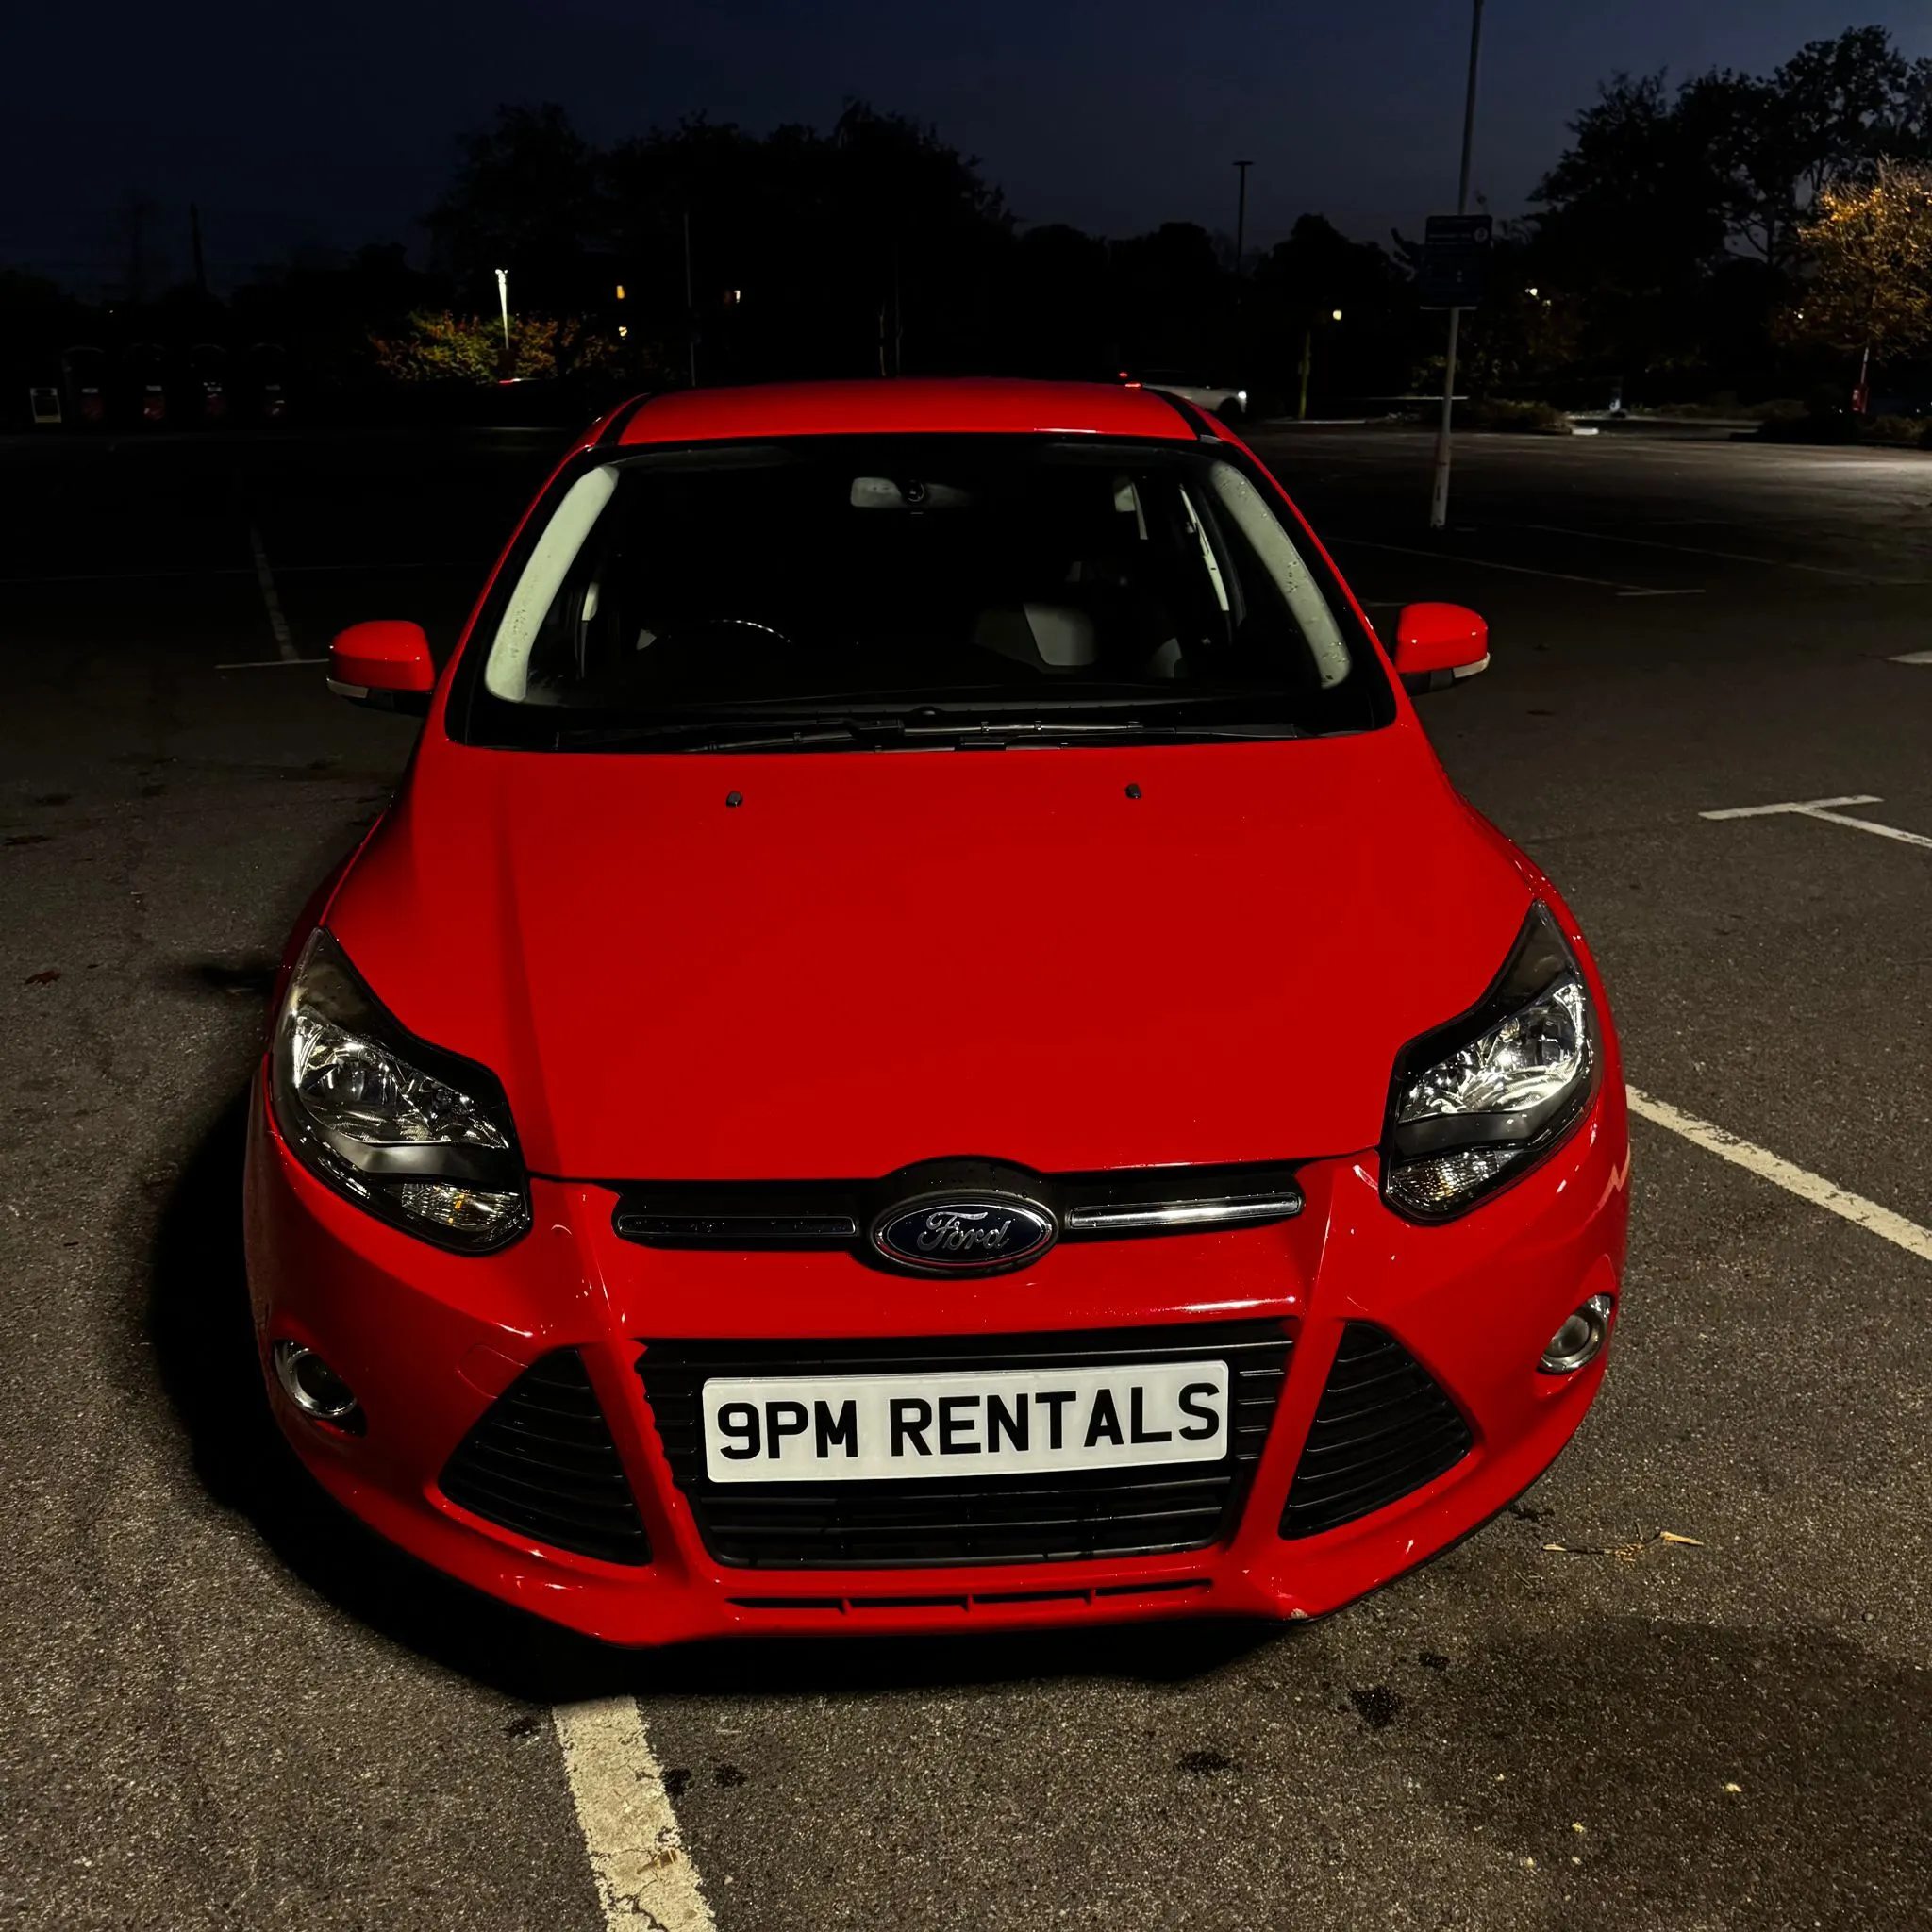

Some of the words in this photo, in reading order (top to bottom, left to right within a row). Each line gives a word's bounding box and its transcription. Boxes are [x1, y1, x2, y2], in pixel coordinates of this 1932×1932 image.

[916, 1211, 1011, 1251] Ford
[717, 1401, 858, 1459] 9PM
[890, 1382, 1220, 1457] RENTALS
